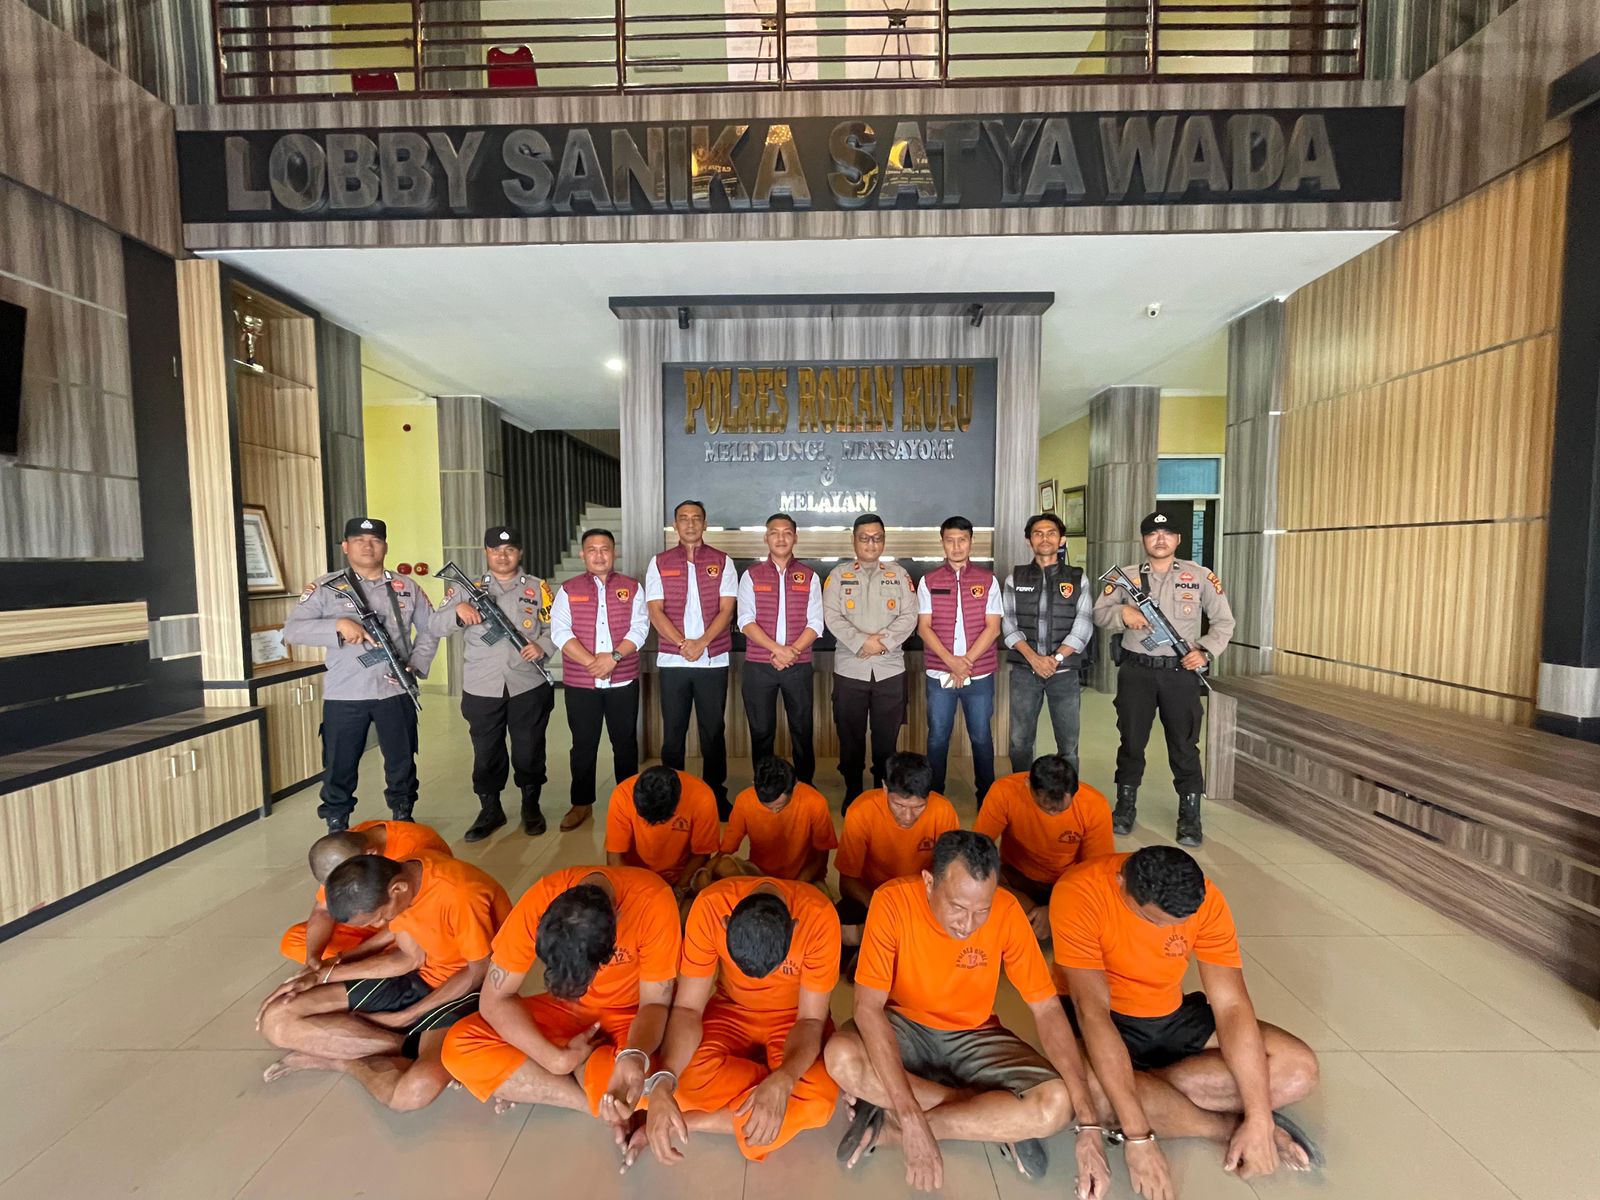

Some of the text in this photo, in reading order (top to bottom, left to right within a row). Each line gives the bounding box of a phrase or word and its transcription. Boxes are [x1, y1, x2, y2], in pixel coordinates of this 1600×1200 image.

[224, 113, 1341, 213] LOBBY SANIKA SATYA WADA
[684, 365, 975, 434] POLRES ROKAN HULU
[842, 438, 955, 462] MENGAYOMI
[779, 490, 877, 513] MELAYANI
[1175, 582, 1199, 590] POLRI
